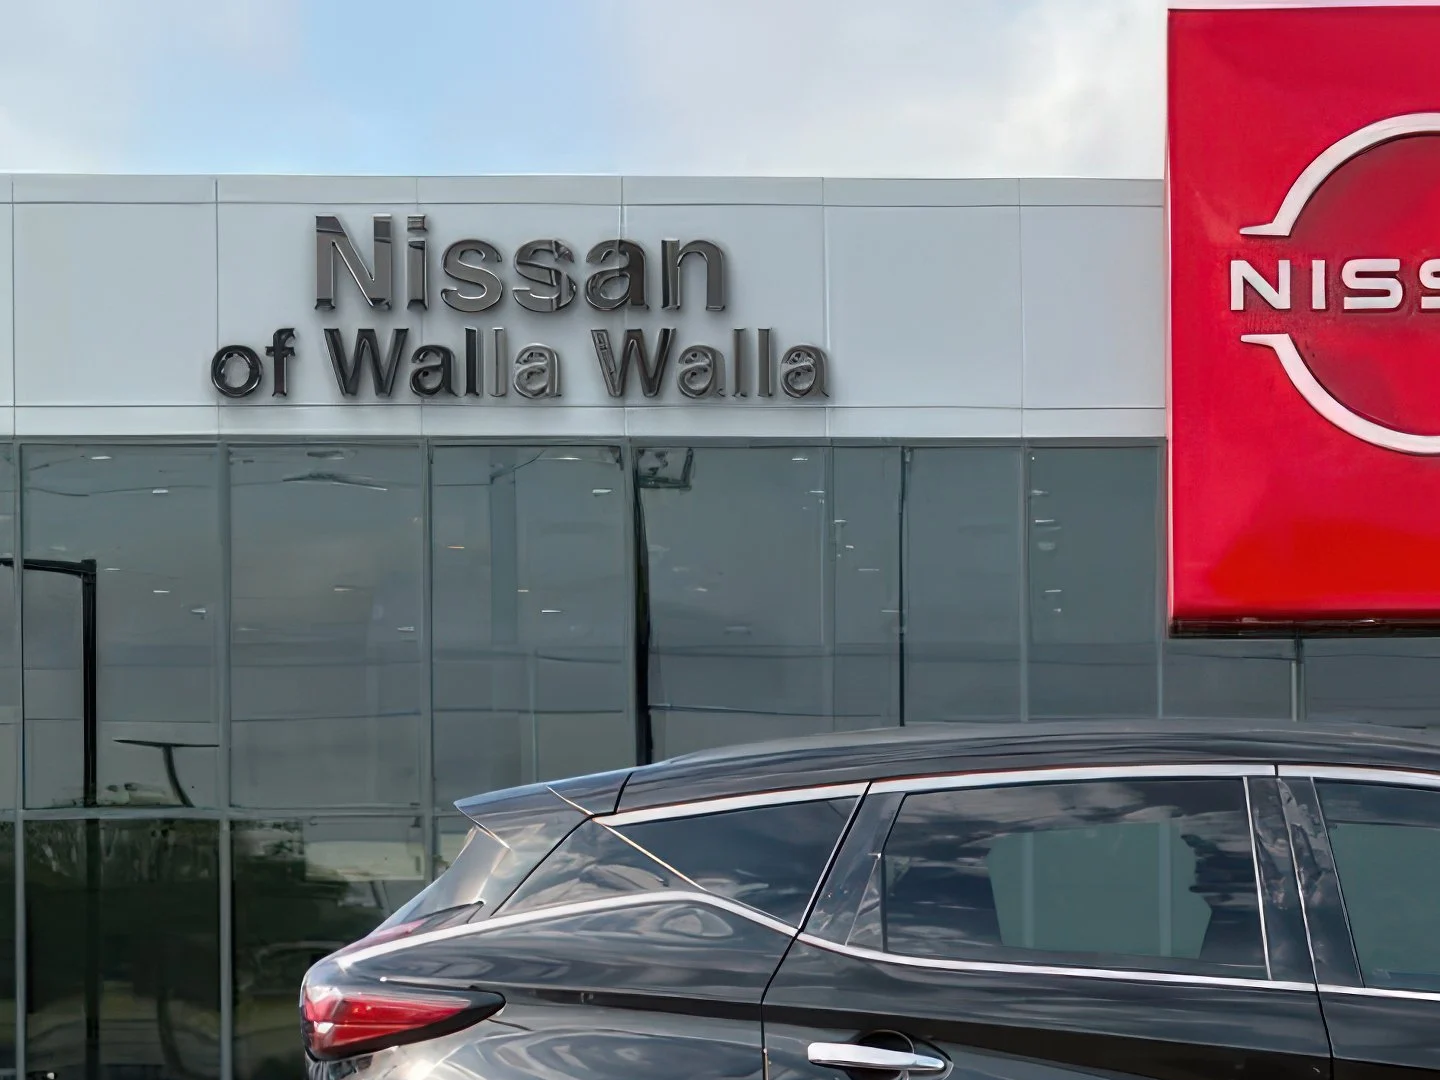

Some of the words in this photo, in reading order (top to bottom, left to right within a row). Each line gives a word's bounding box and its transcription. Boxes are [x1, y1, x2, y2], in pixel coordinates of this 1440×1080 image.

[313, 214, 729, 313] Nissan
[210, 327, 296, 398] of
[322, 327, 563, 398] Walla
[589, 327, 831, 398] Walla
